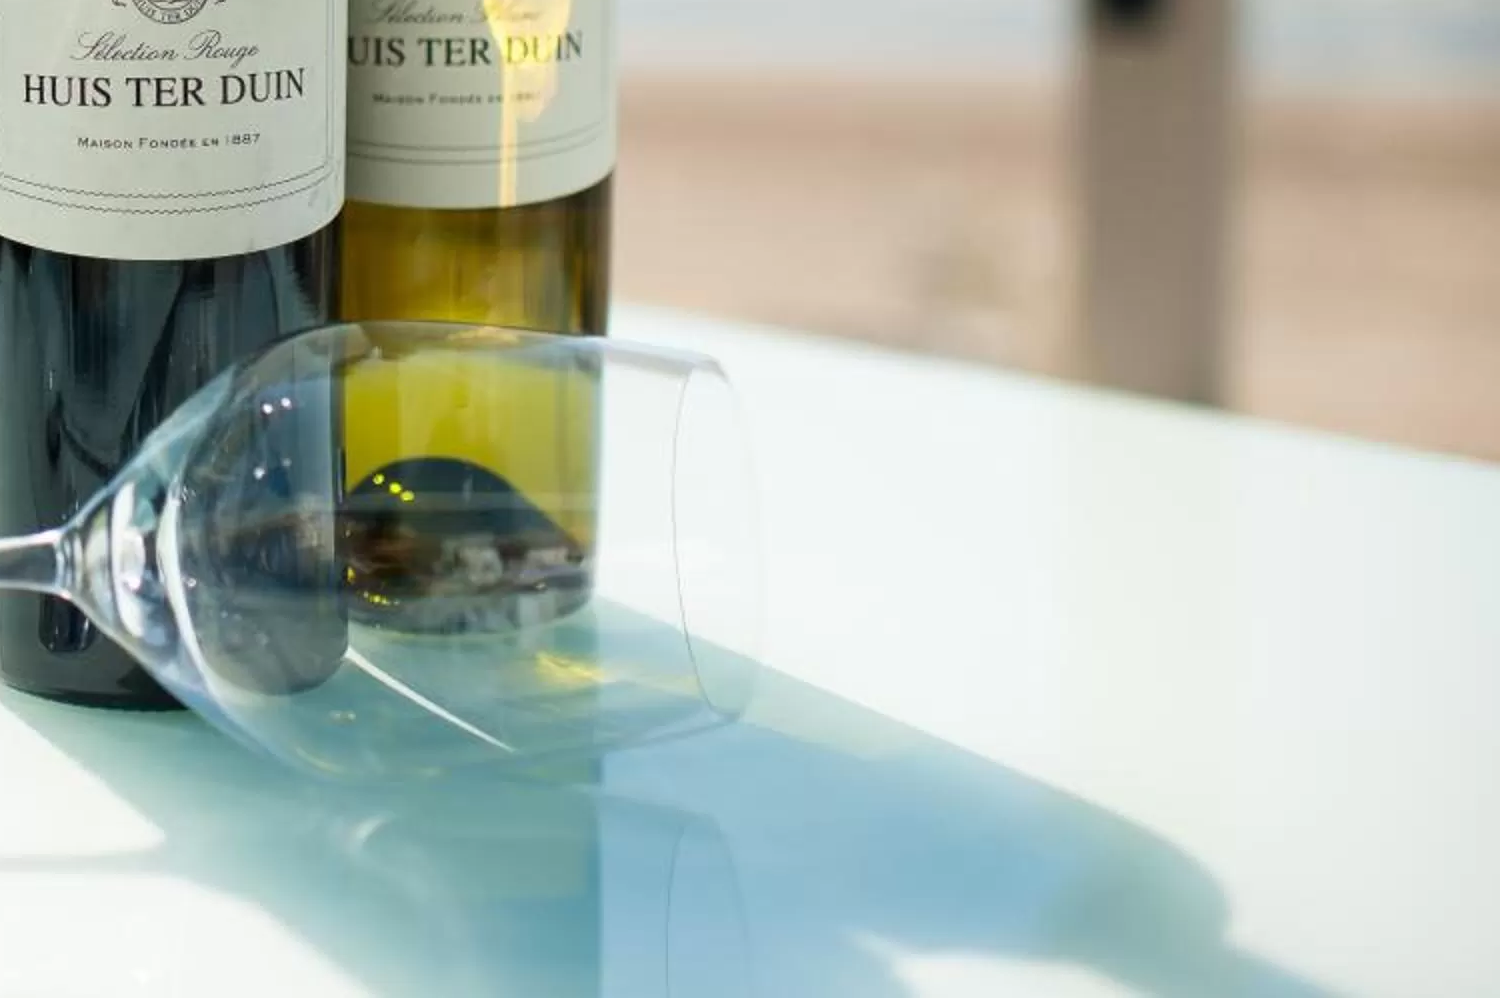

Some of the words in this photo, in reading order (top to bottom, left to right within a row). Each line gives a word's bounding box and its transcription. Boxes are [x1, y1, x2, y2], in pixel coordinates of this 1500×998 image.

[184, 29, 260, 69] Rouge
[347, 35, 405, 67] UIS
[417, 37, 492, 67] TER
[505, 30, 583, 64] DUIN
[24, 74, 112, 108] HUIS
[125, 76, 206, 107] TER
[220, 68, 305, 105] DUIN
[227, 133, 261, 146] 1887
